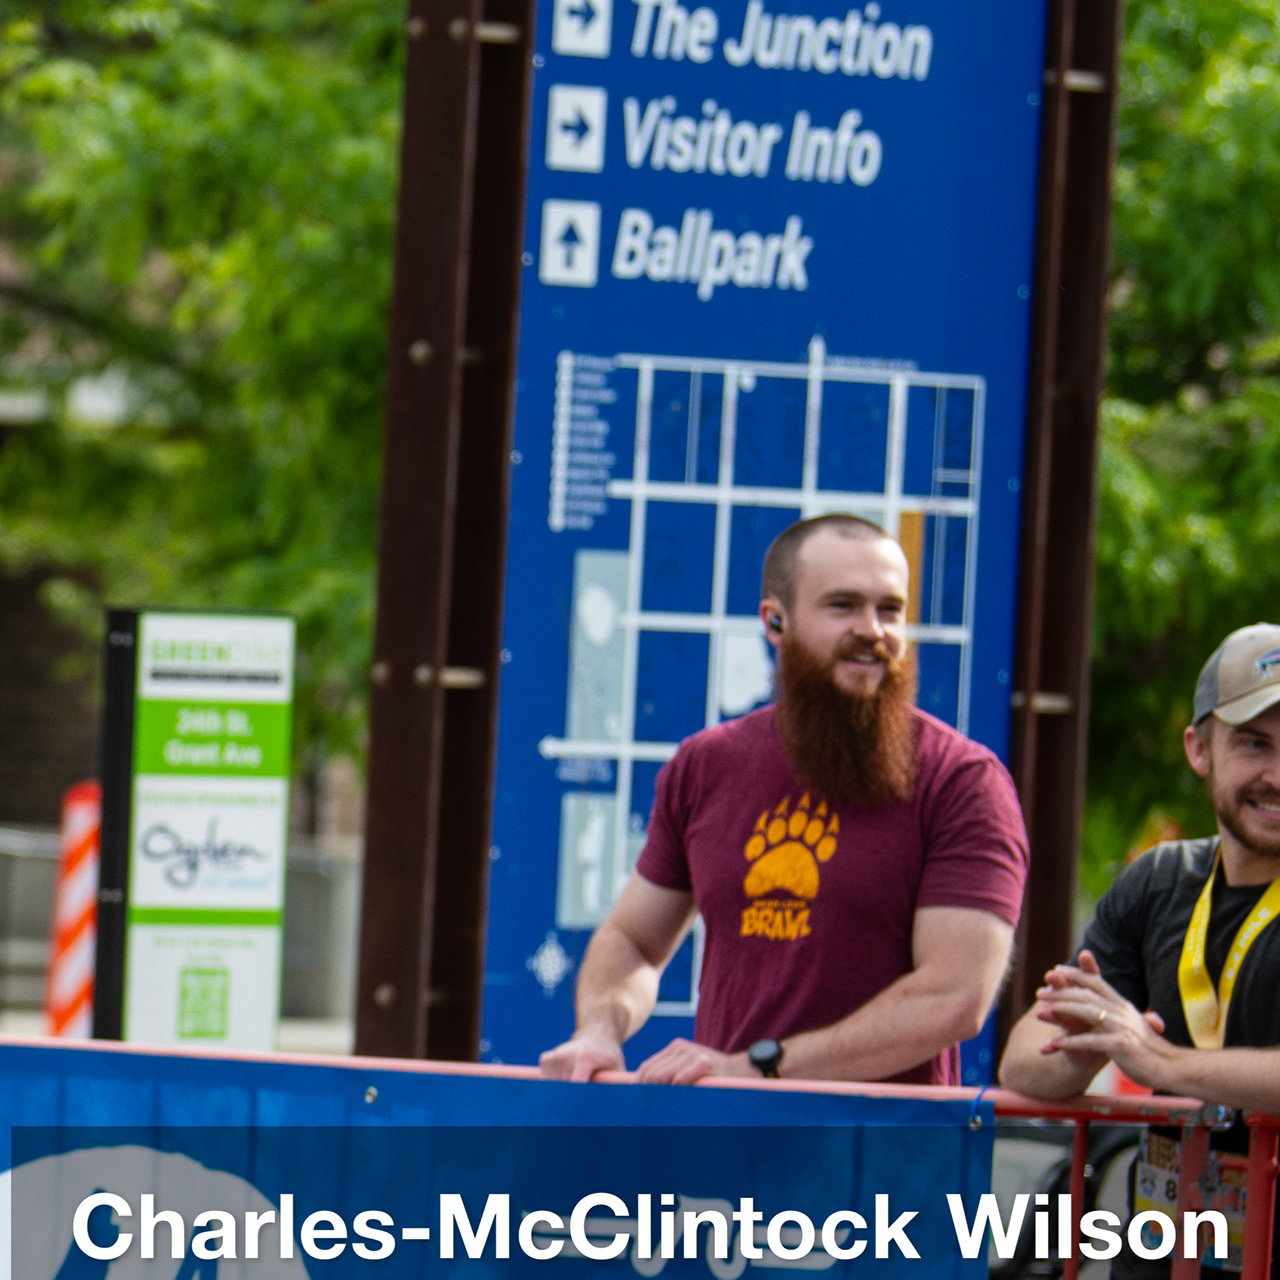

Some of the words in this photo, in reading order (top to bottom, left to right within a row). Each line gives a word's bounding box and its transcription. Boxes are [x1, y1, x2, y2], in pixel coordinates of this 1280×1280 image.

[632, 0, 719, 63] The
[722, 2, 933, 81] Junction
[622, 96, 785, 178] Visitor
[785, 109, 882, 187] Info
[612, 206, 813, 301] Ballpark
